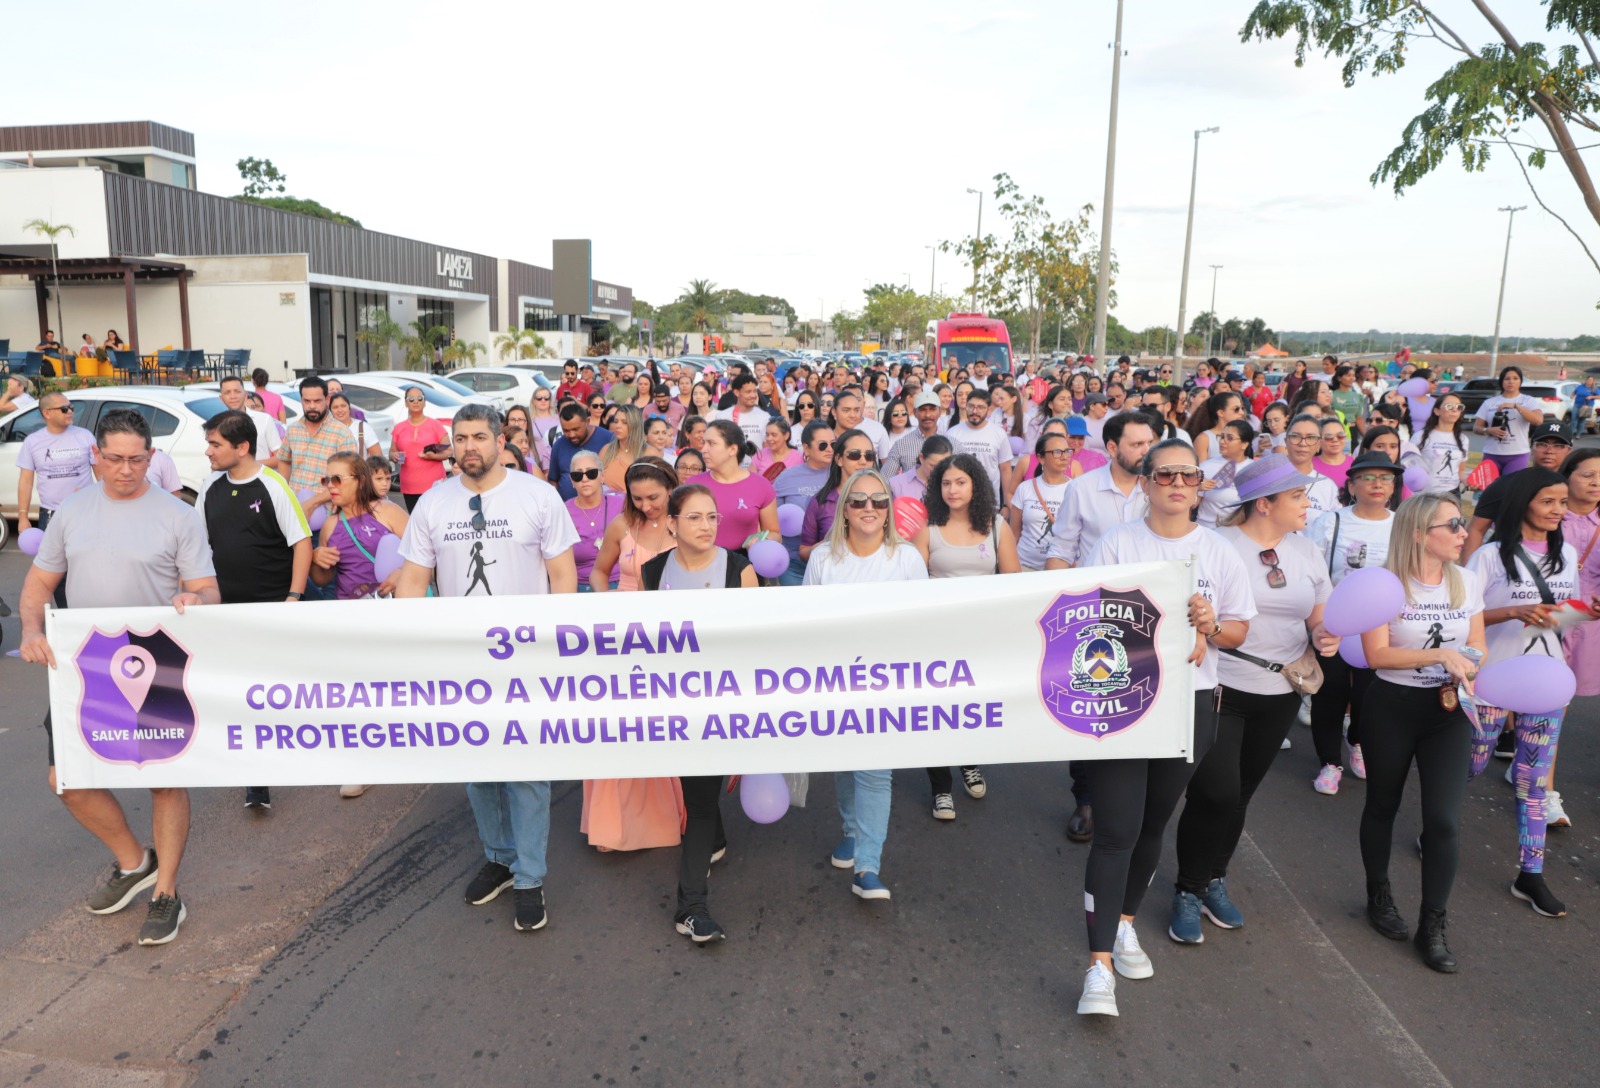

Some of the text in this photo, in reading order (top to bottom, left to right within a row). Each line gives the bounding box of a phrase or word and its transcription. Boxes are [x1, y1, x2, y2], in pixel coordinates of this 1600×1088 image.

[443, 528, 513, 542] AGOSTO LILÁS
[1065, 602, 1136, 624] POLÍCIA
[555, 620, 701, 657] DEAM
[245, 655, 977, 710] COMBATENDO A VIOLÊNCIA DOMÉSTICA
[1070, 699, 1128, 716] CIVIL
[92, 728, 185, 741] SALVE MULHER
[226, 701, 1004, 750] E PROTEGENDO A MULHER ARAGUAINENSE
[1090, 722, 1109, 732] TO
